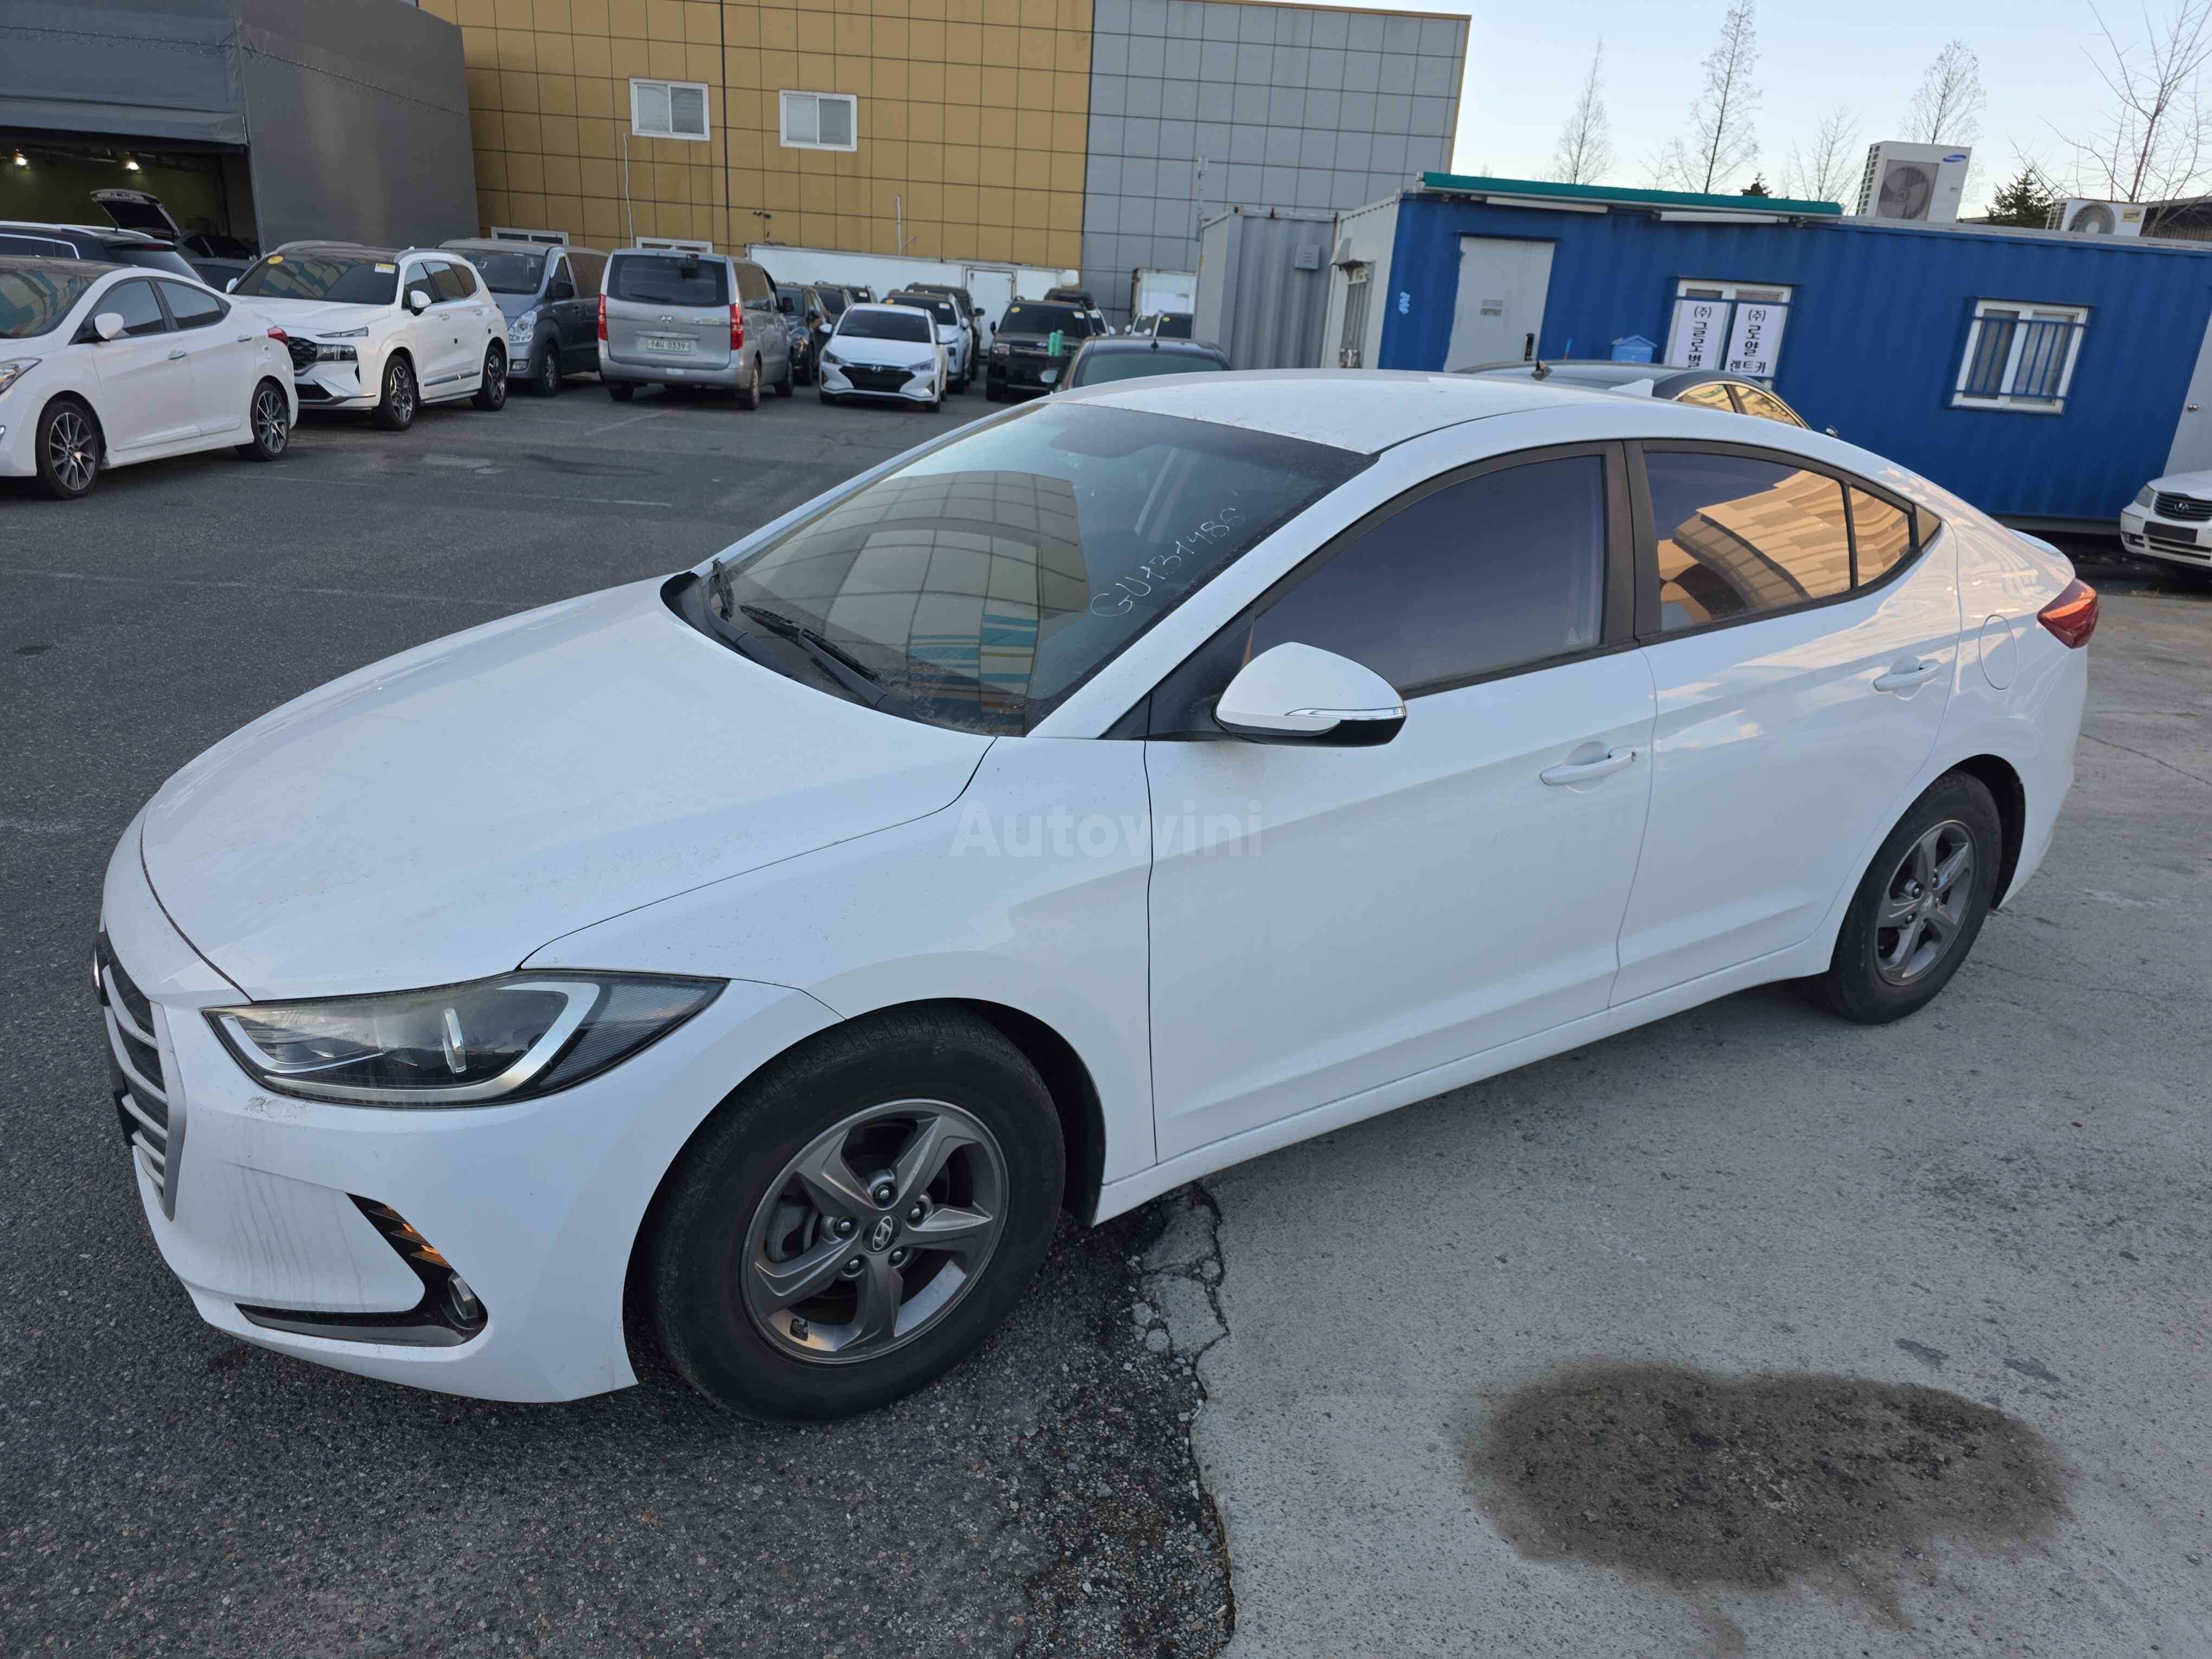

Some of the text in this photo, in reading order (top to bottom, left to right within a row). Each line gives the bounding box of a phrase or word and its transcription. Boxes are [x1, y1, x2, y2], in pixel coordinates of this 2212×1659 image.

[1694, 306, 1712, 318] (주)
[1744, 309, 1766, 357] (주) 로얄
[1730, 360, 1766, 374] 렌트카
